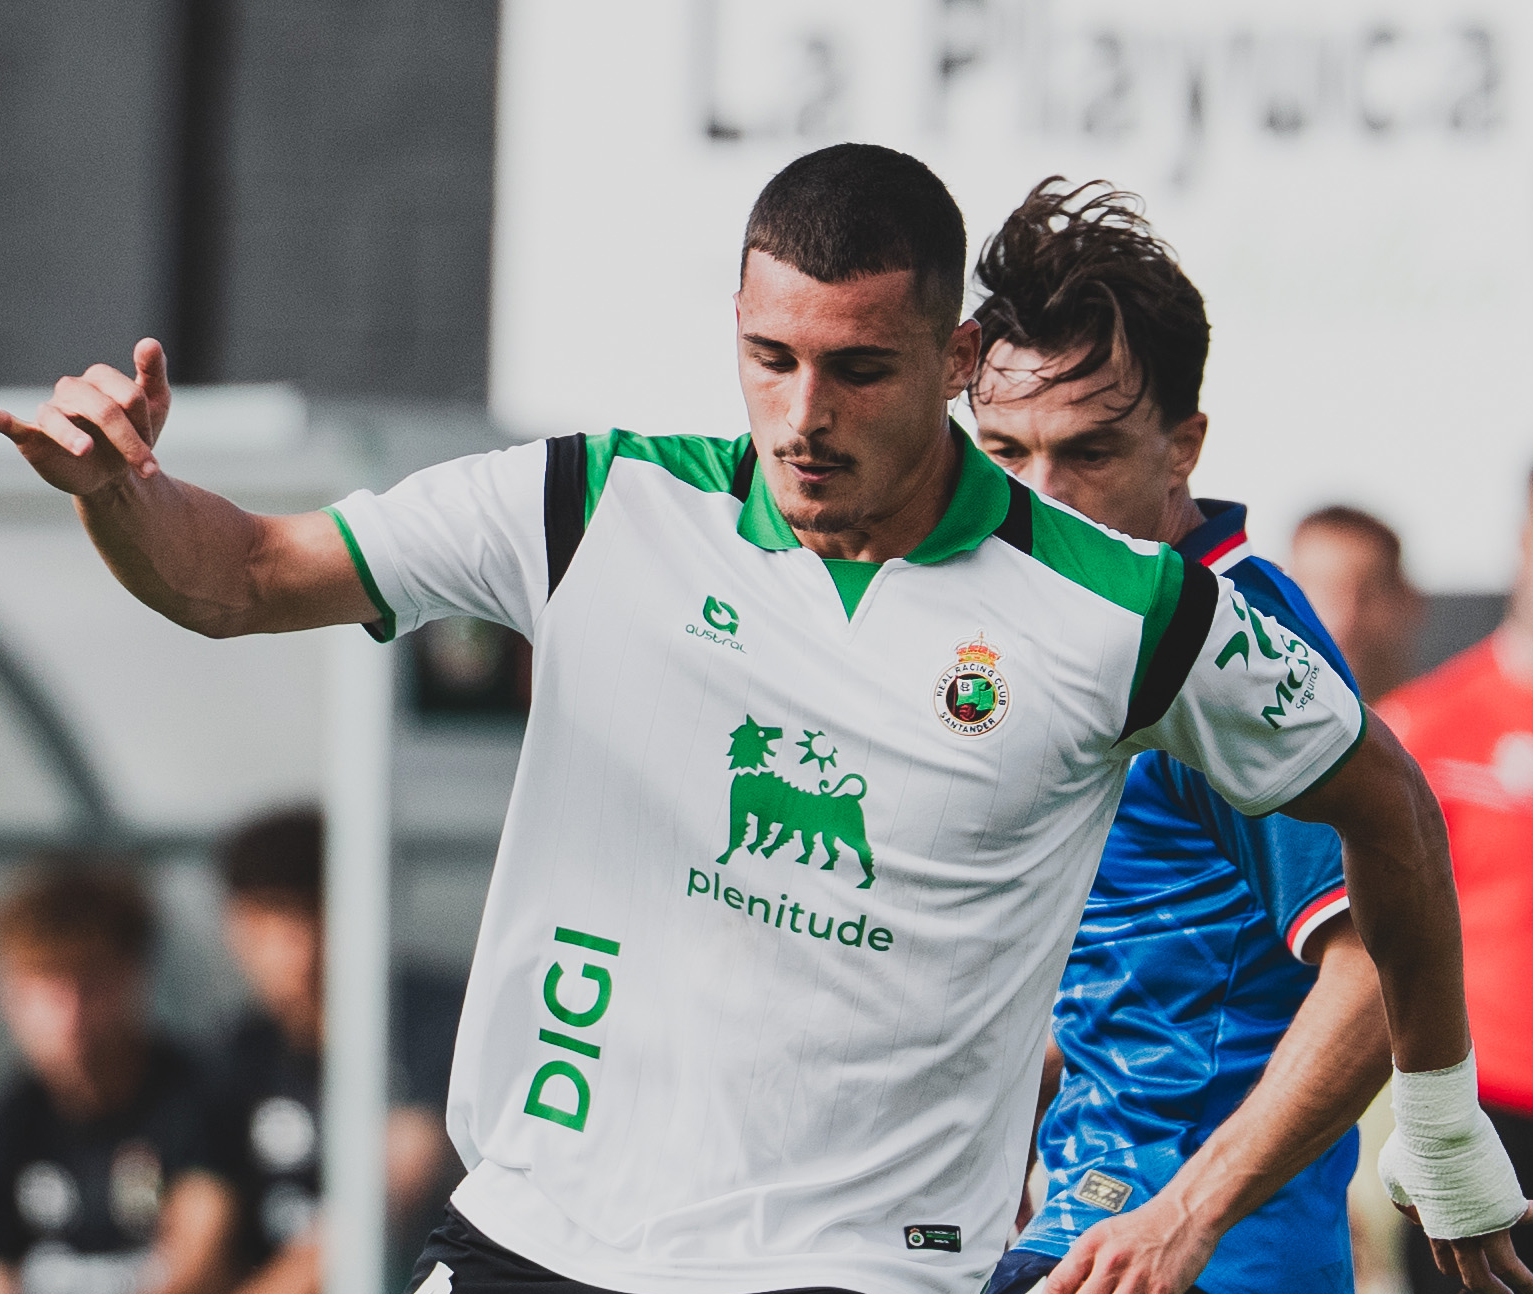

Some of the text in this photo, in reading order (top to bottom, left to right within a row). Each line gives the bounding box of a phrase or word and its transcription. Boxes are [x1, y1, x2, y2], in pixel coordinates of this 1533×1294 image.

[930, 0, 1508, 196] Playuca
[936, 663, 1007, 706] REAL RACING CLUB
[940, 711, 996, 733] SANTANDER
[1261, 634, 1311, 730] MGS
[1295, 664, 1320, 712] Seguros
[686, 867, 894, 952] plenitude
[523, 926, 621, 1133] DIGI
